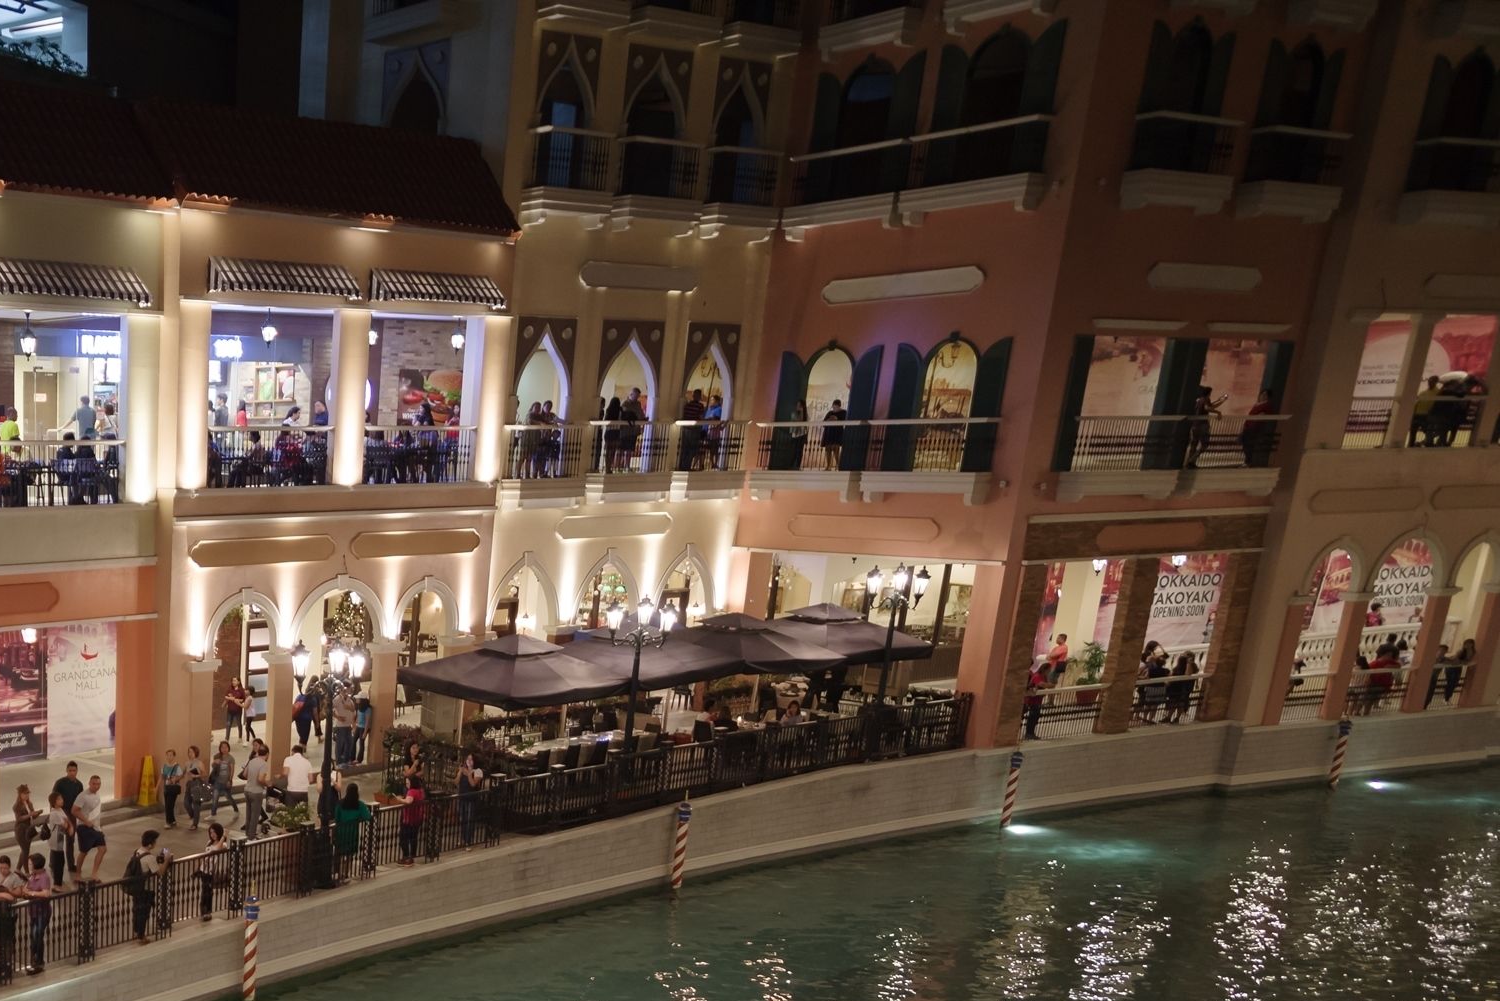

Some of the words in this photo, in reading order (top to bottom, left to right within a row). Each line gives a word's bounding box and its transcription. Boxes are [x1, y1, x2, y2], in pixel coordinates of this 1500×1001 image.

[1152, 605, 1186, 618] OPENING
[1186, 604, 1205, 617] SOON
[75, 680, 100, 691] MALL
